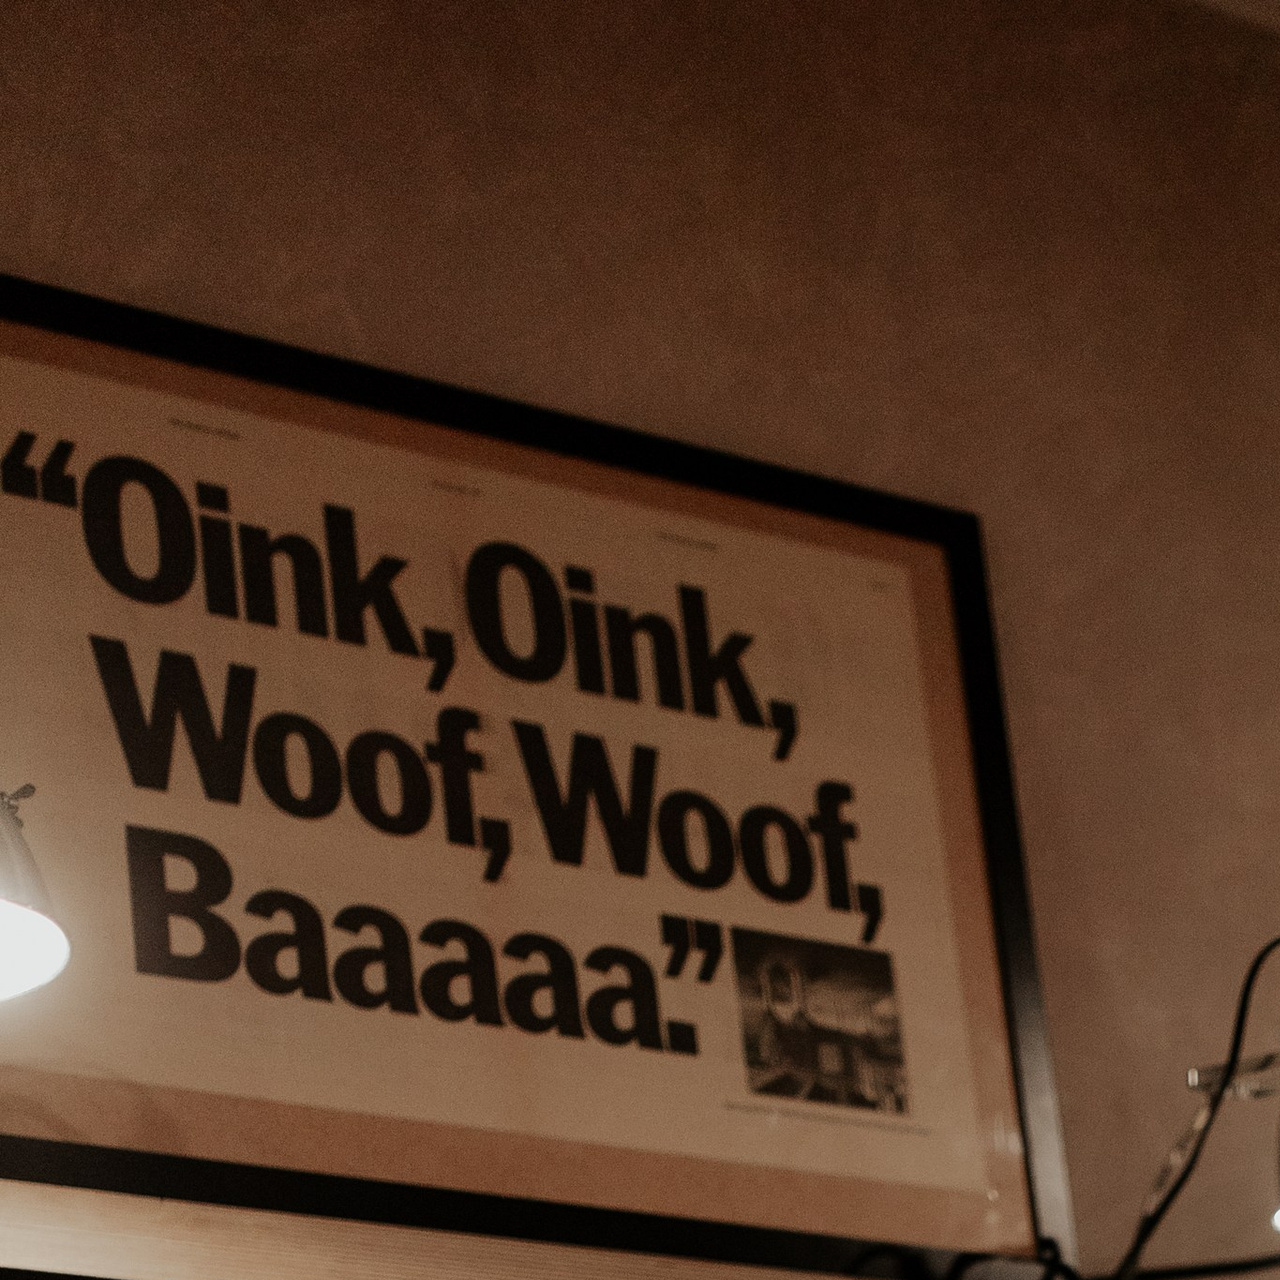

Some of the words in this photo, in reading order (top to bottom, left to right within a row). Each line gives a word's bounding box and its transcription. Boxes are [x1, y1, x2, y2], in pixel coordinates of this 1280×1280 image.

[1, 430, 457, 694] “Oink,
[464, 540, 799, 762] Oink,
[89, 632, 514, 884] Woof,
[511, 718, 885, 944] Woof,
[125, 822, 725, 1056] Baaaaa.”
